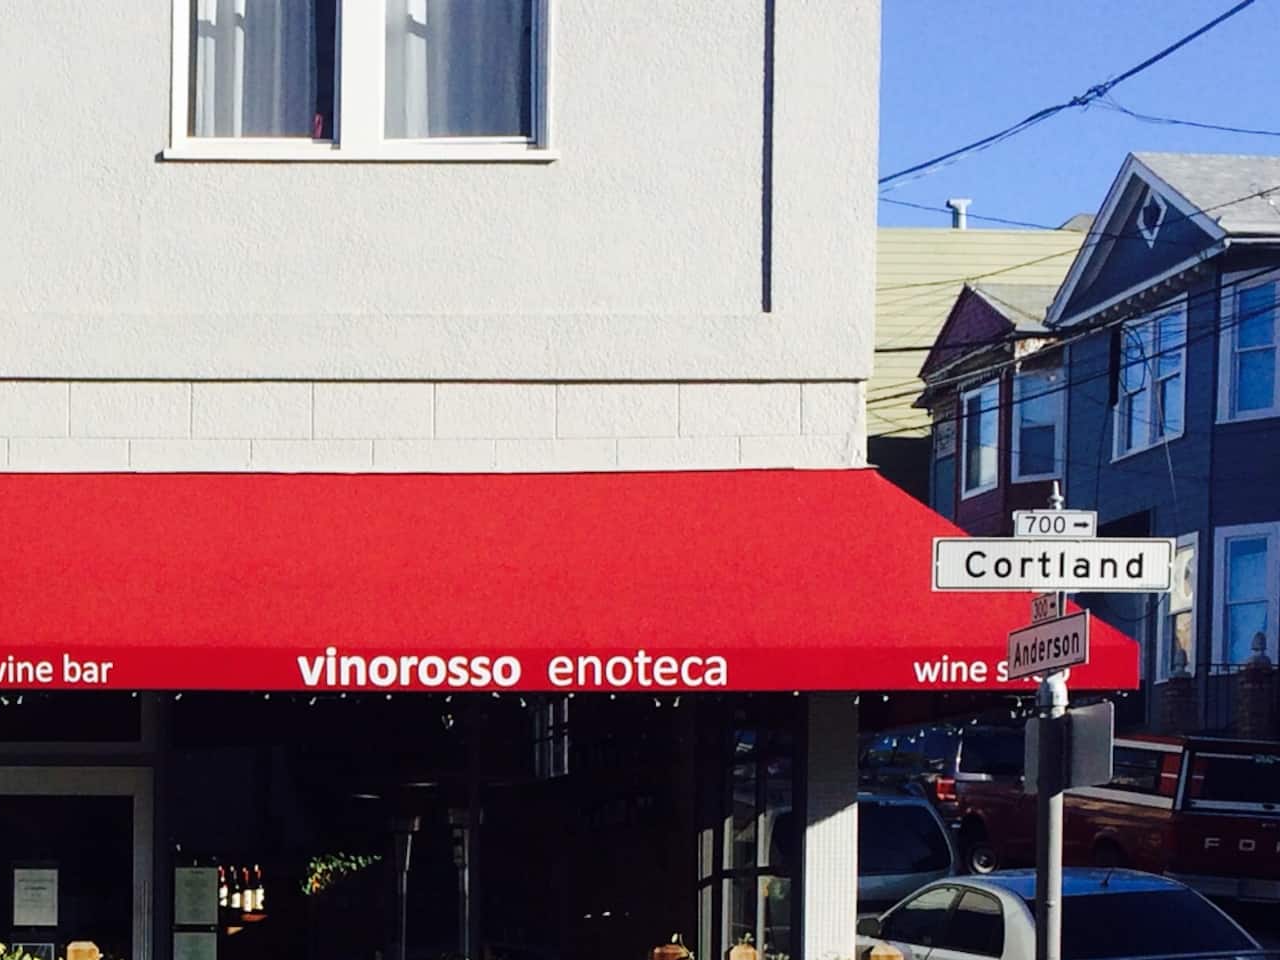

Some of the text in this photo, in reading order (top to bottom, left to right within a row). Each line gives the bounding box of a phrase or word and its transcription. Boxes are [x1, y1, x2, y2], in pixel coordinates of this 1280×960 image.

[1025, 515, 1066, 534] 700
[965, 550, 1144, 579] Cortland
[1014, 632, 1080, 668] Anderson
[63, 653, 114, 683] bar
[297, 646, 728, 687] vinorosso enoteca
[913, 654, 988, 683] wine
[1204, 837, 1280, 853] FO
